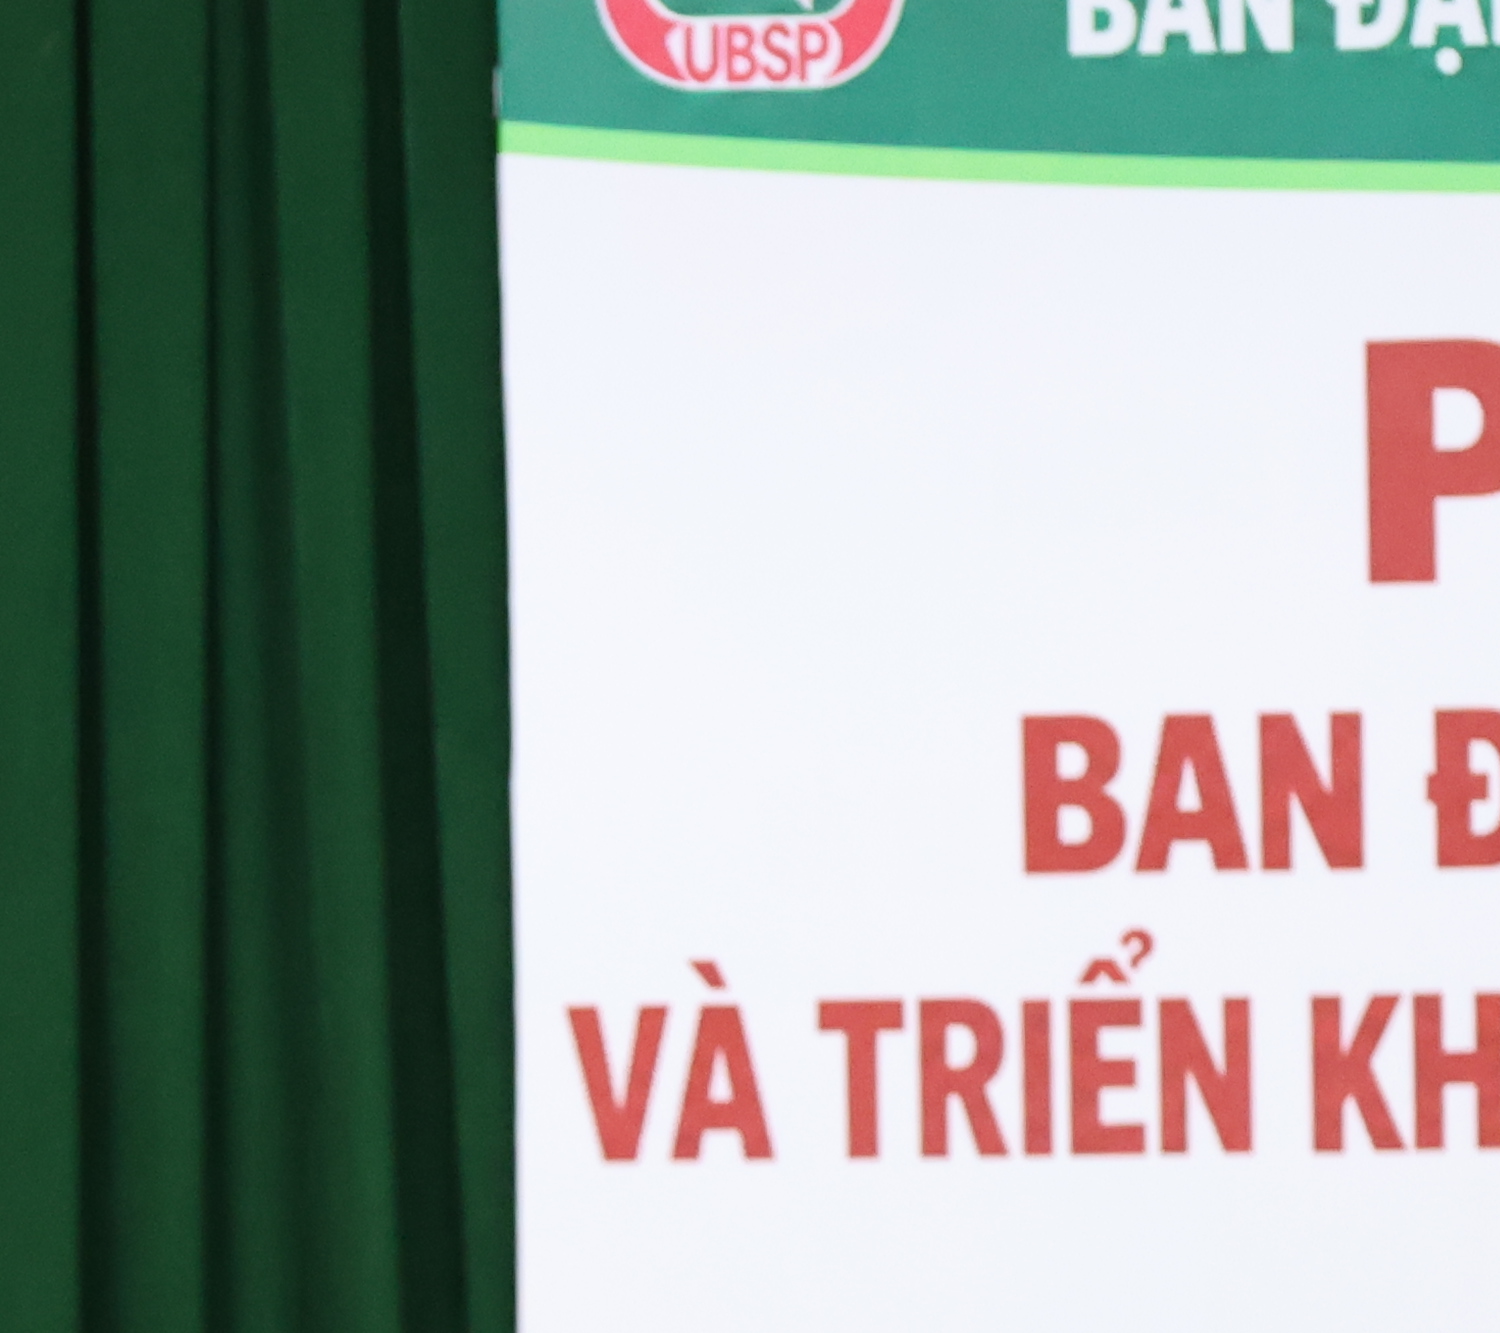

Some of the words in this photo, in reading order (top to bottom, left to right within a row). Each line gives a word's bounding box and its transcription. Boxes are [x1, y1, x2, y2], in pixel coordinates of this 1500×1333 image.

[1022, 712, 1364, 874] BAN
[567, 961, 774, 1162] VÀ
[817, 929, 1254, 1158] TRIỂN
